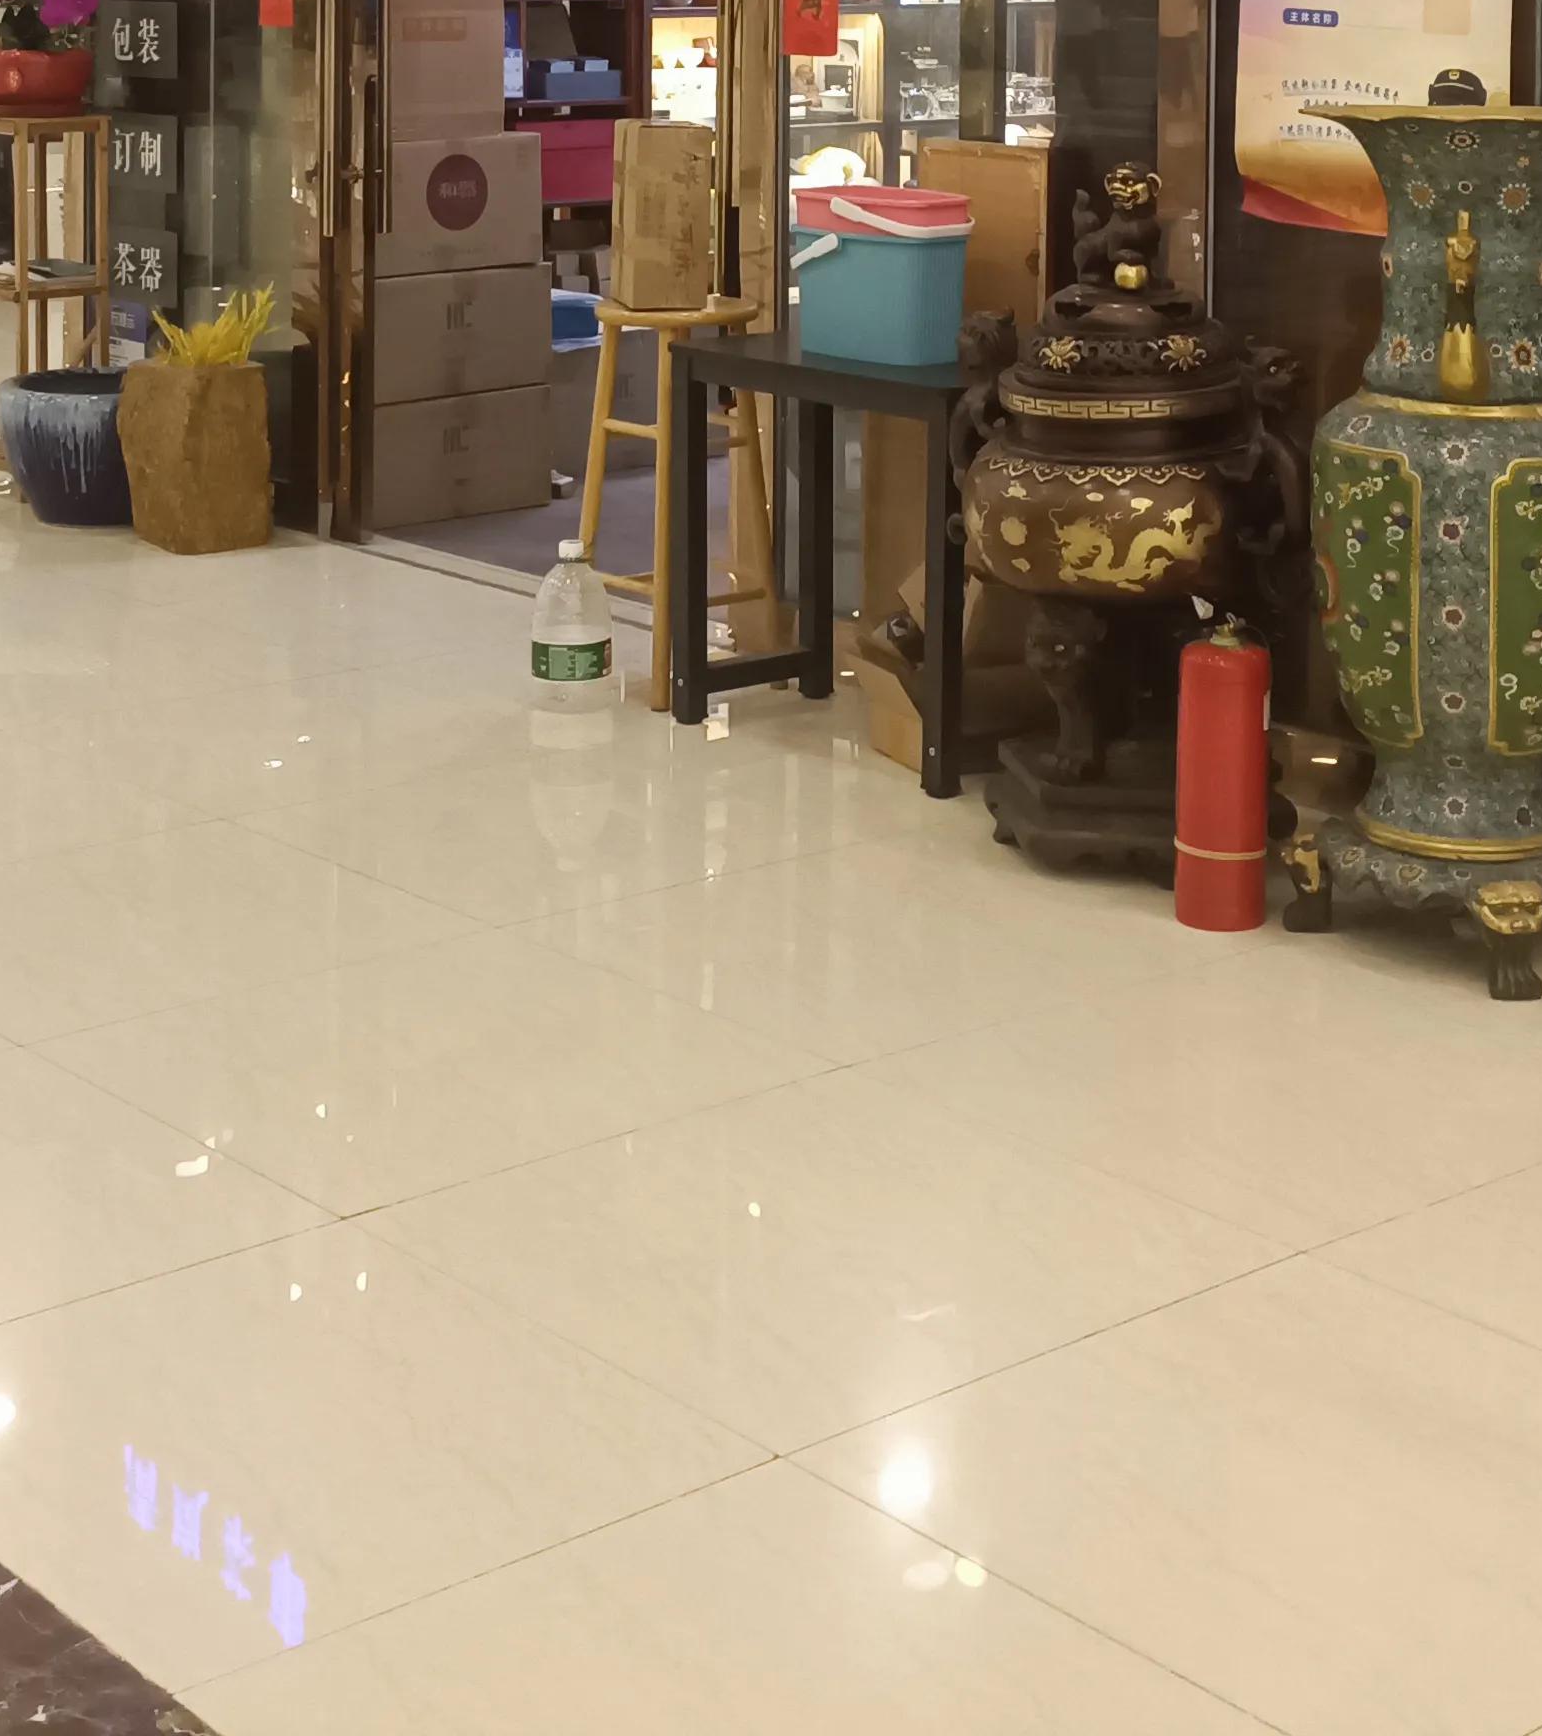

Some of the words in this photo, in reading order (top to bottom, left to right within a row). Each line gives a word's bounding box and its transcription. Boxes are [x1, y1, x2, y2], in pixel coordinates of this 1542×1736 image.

[112, 18, 161, 64] 包装
[112, 128, 163, 177] 订制
[113, 242, 164, 293] 茶器
